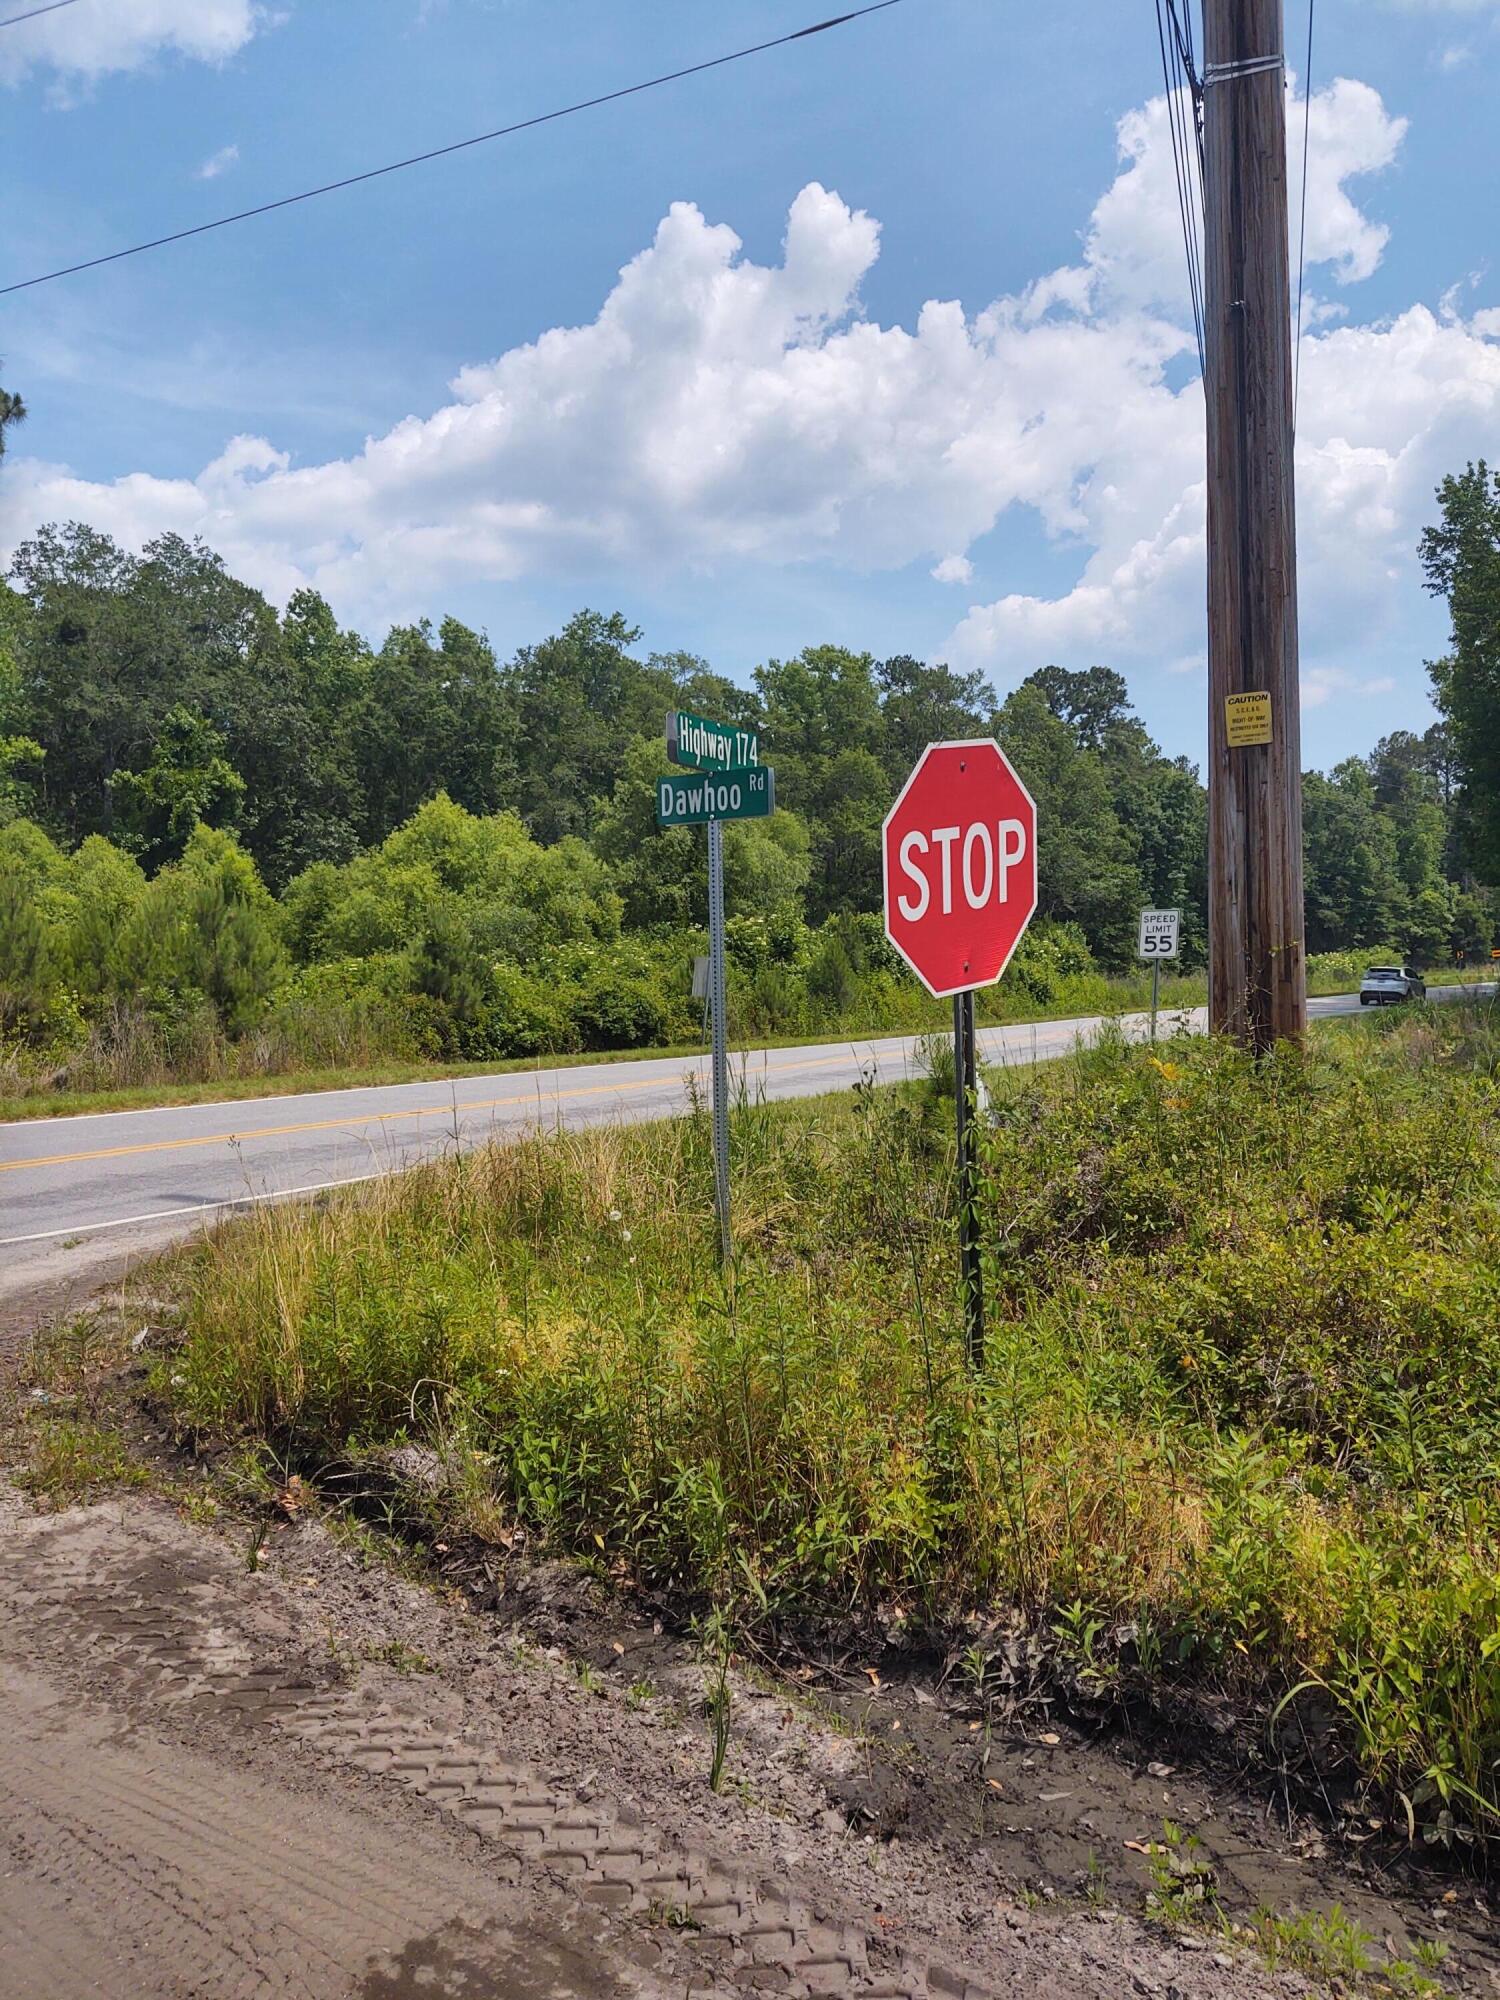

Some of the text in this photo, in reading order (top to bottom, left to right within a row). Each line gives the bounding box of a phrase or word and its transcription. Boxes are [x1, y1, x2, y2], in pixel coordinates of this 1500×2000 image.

[1228, 694, 1268, 705] CAUTION
[680, 715, 758, 771] Highway 174
[661, 773, 764, 817] Dawhoo Rd
[898, 818, 1027, 921] STOP
[1143, 915, 1176, 923] SPEED
[1146, 925, 1171, 933] LIMIT
[1144, 936, 1172, 952] 55
